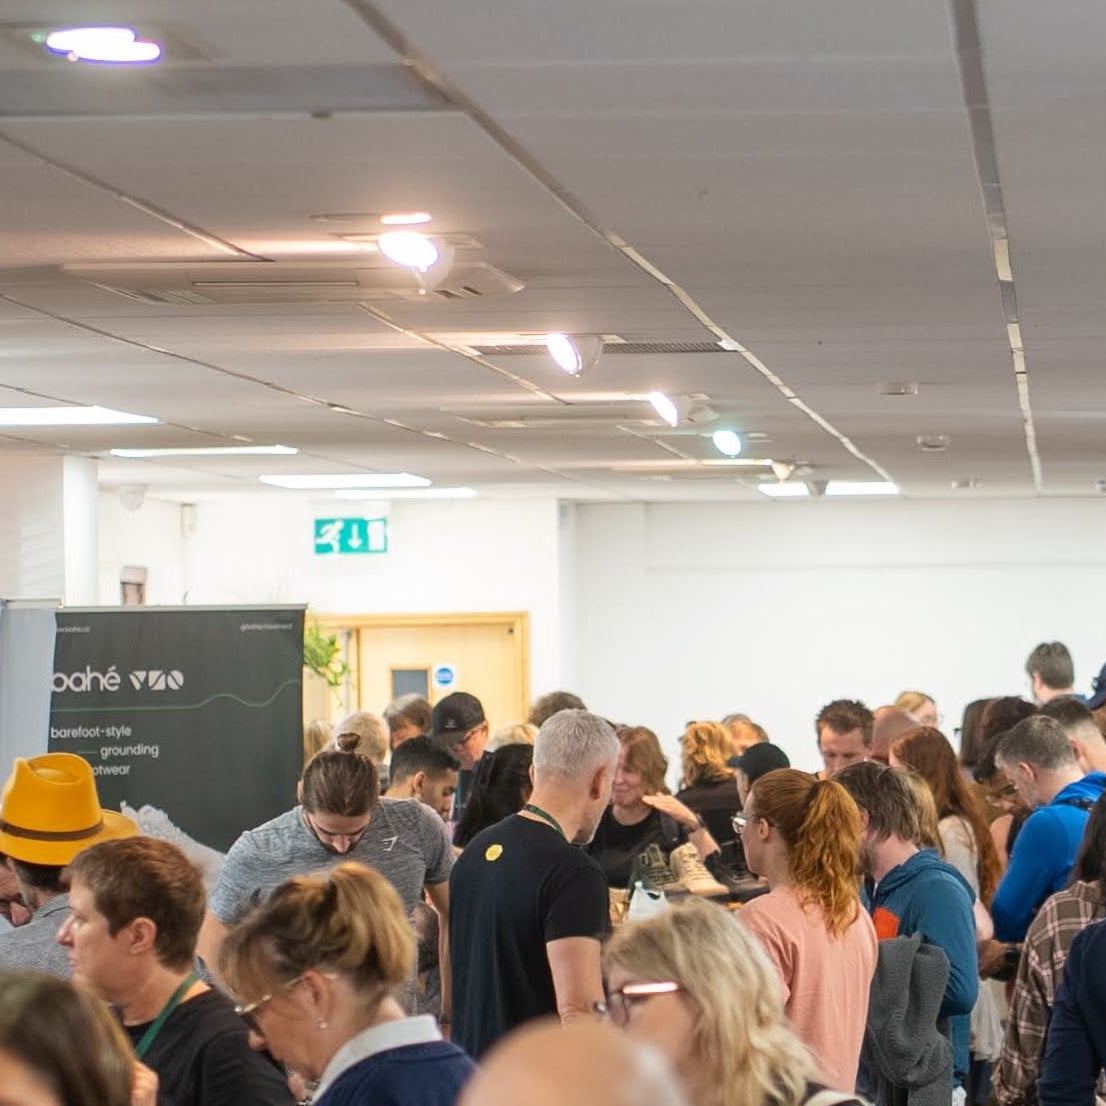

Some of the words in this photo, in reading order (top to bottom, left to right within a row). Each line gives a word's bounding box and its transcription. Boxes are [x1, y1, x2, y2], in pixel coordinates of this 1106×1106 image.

[51, 726, 132, 739] barefoot-style
[100, 743, 159, 759] grounding
[93, 765, 130, 776] otwear
